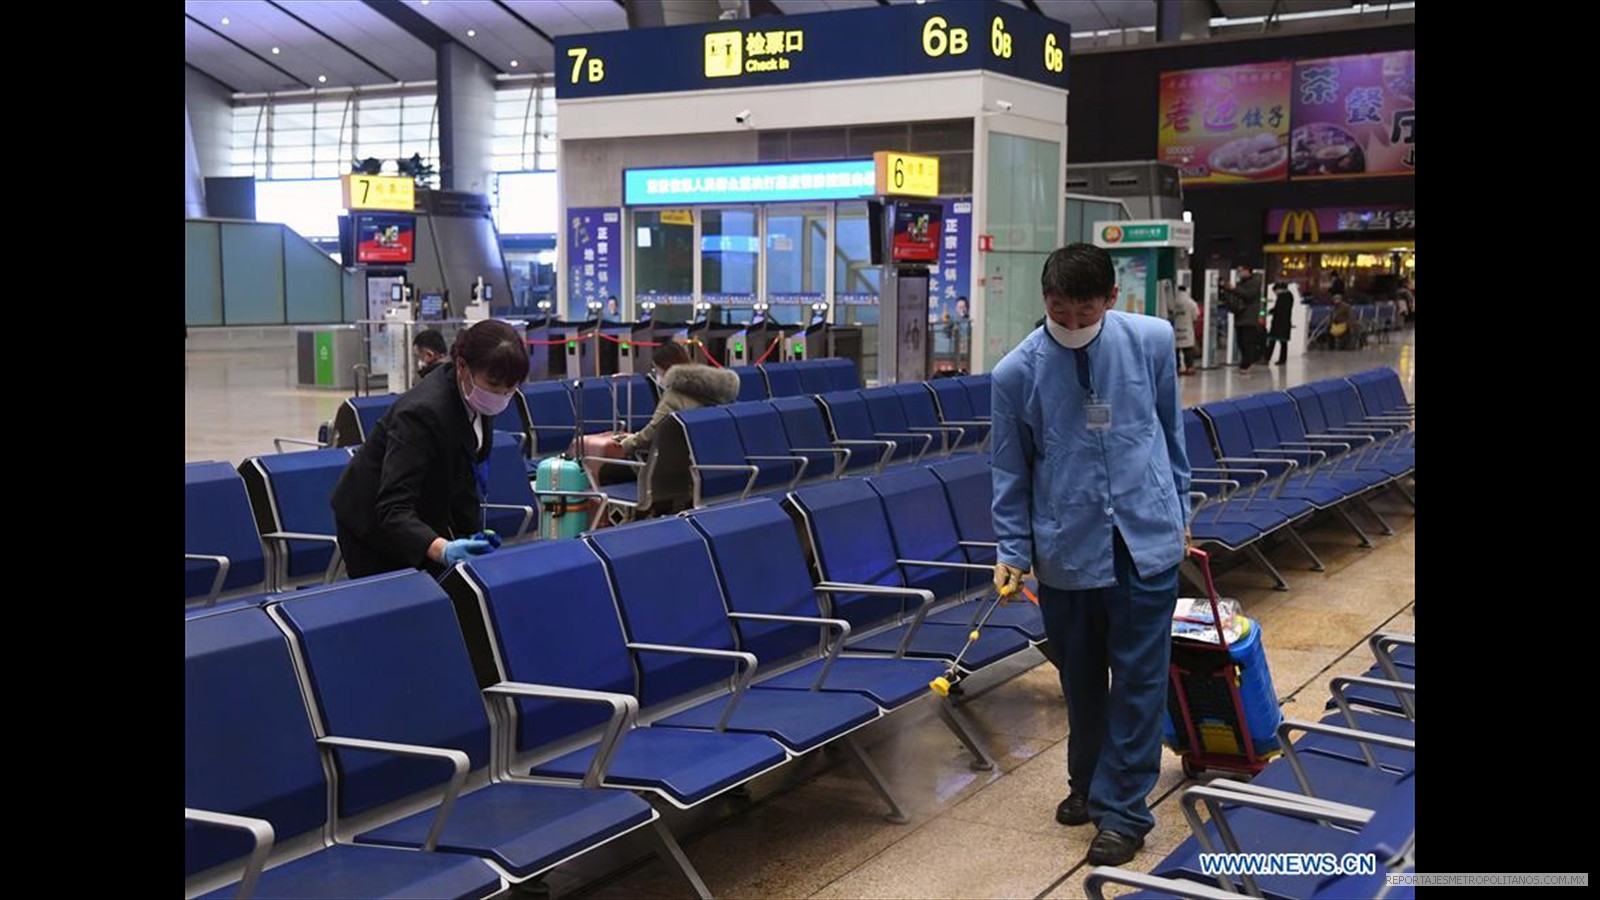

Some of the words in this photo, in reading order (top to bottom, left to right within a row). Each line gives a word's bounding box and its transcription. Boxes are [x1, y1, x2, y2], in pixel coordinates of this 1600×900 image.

[745, 30, 803, 56] 检票口
[922, 16, 969, 55] 6B
[990, 16, 1012, 60] 6B
[1044, 32, 1063, 72] 6B
[567, 47, 604, 84] 7B
[745, 58, 778, 72] Check
[894, 157, 905, 189] 6
[359, 179, 370, 205] 7
